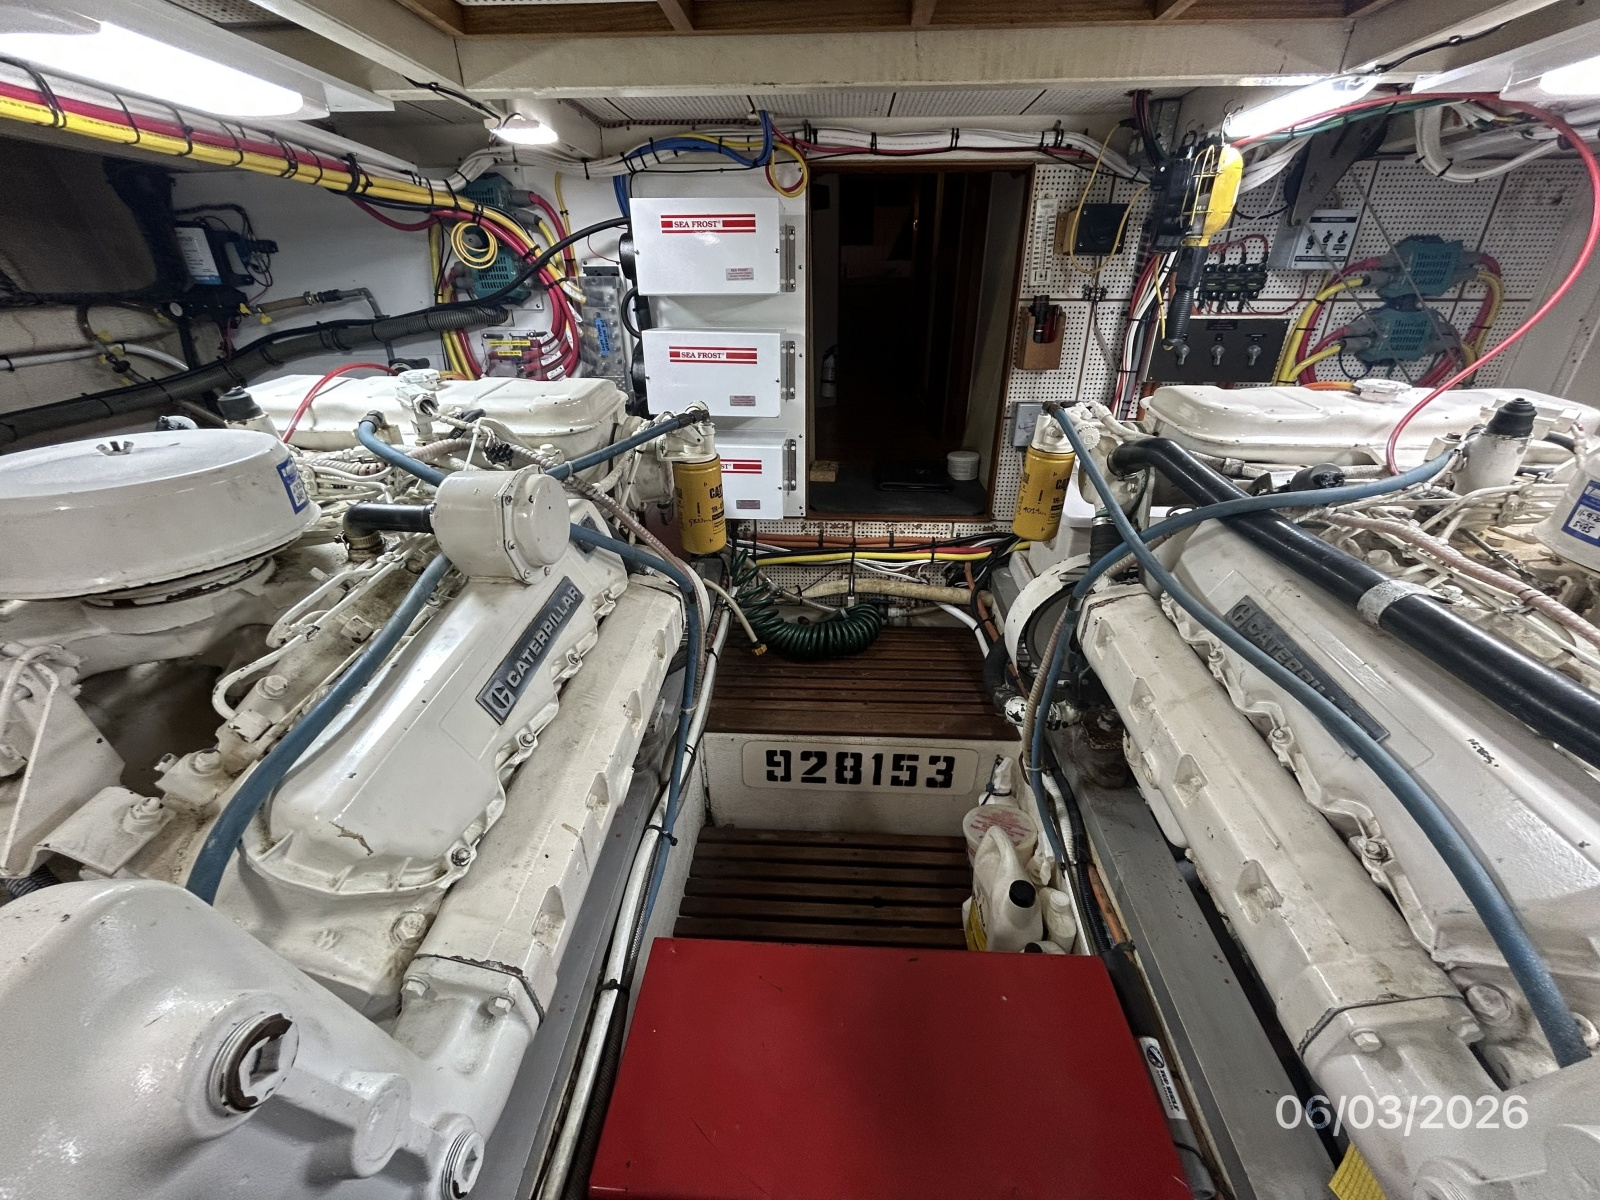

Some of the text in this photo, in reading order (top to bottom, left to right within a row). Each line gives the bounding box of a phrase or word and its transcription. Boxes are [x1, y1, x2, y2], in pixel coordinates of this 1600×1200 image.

[674, 220, 690, 228] SEA
[507, 587, 579, 687] CATERPILLAR
[765, 749, 956, 789] 928153
